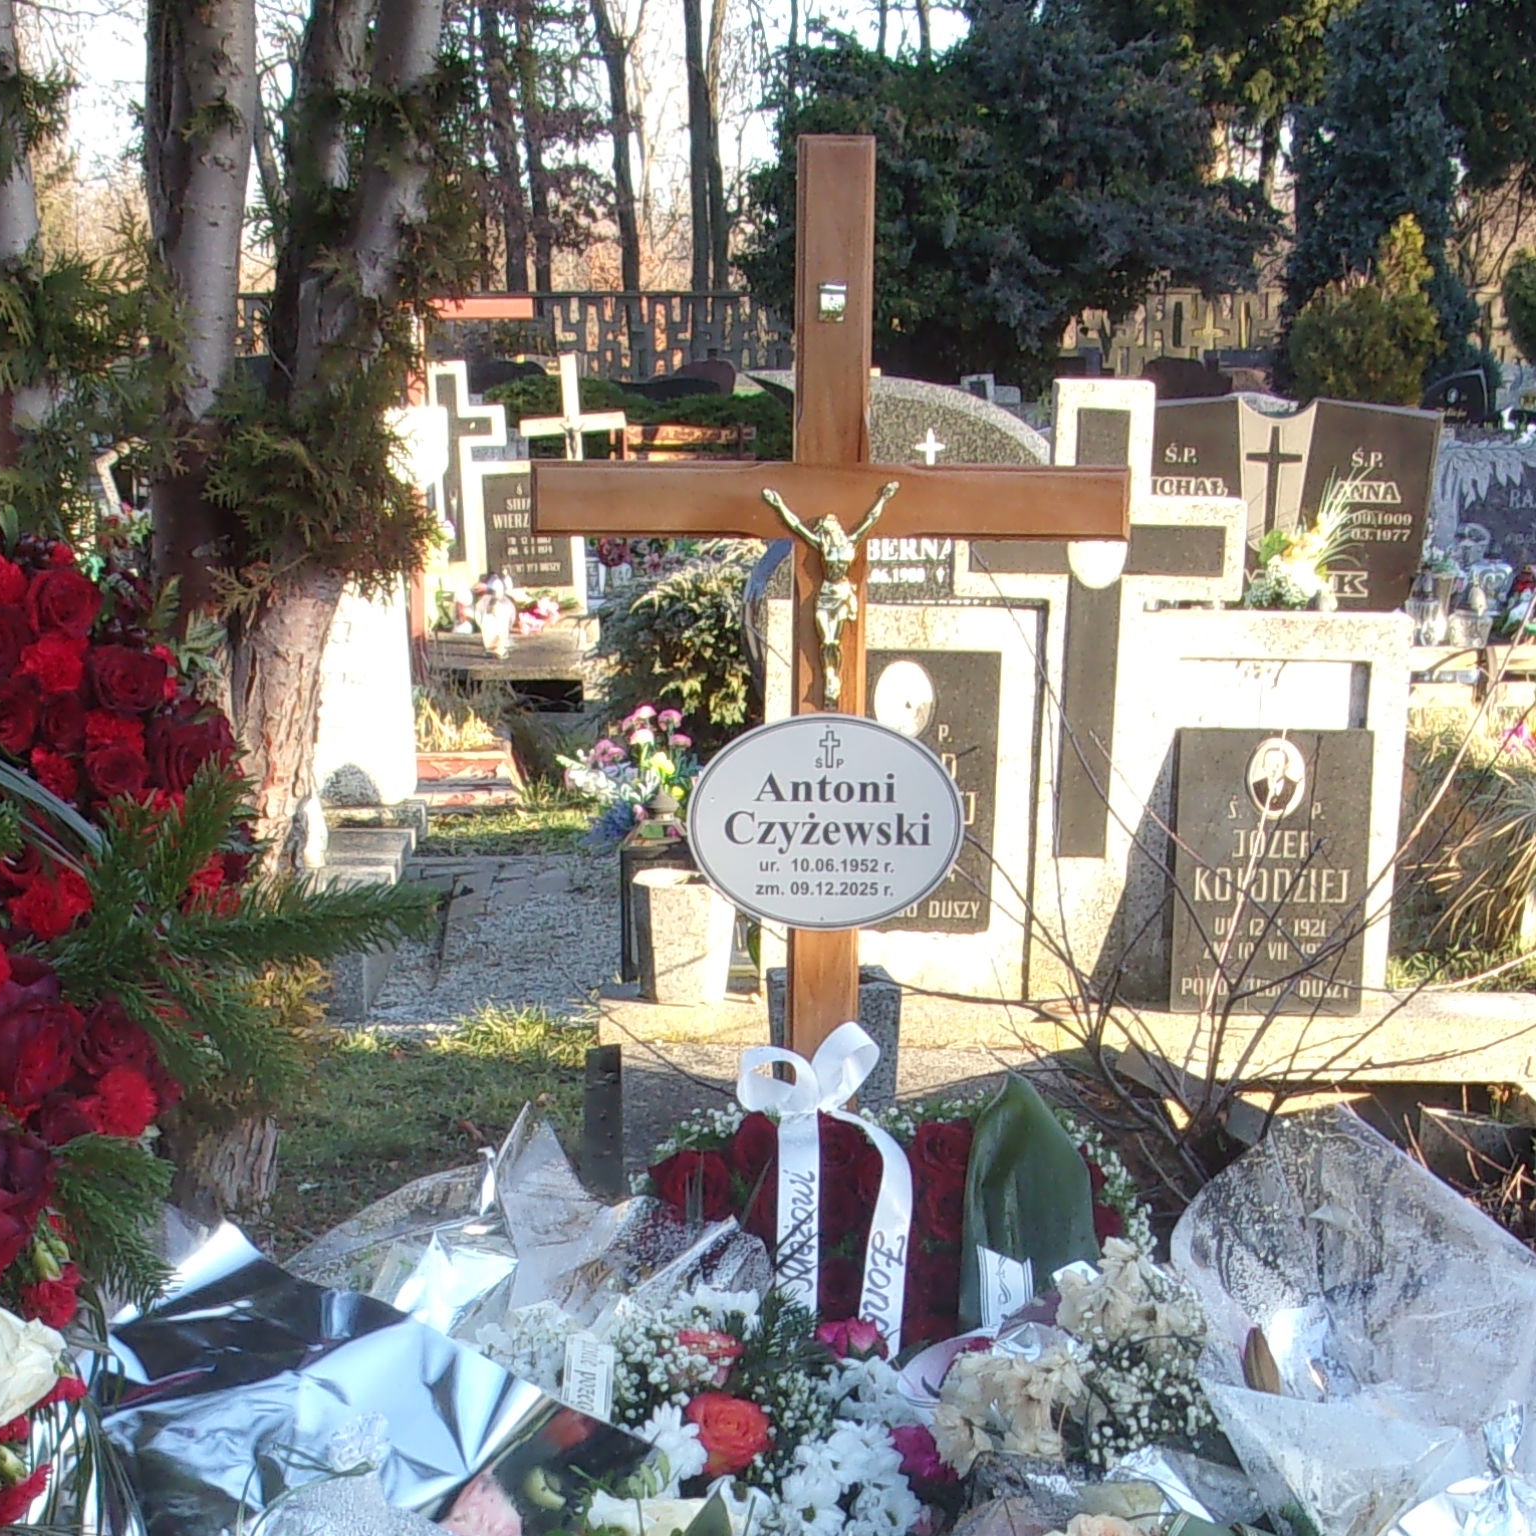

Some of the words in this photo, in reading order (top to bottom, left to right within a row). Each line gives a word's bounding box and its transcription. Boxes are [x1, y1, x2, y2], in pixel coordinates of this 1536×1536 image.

[1151, 477, 1228, 497] ICHAŁ
[753, 771, 896, 804] Antoni
[724, 810, 931, 855] Czyżewski
[759, 860, 780, 873] ur.
[791, 858, 879, 873] 10.06.1952
[884, 861, 895, 873] r.
[755, 884, 785, 896] zm.
[790, 881, 879, 896] 09.12.2025
[884, 884, 894, 896] r.
[928, 901, 982, 919] DUSZY
